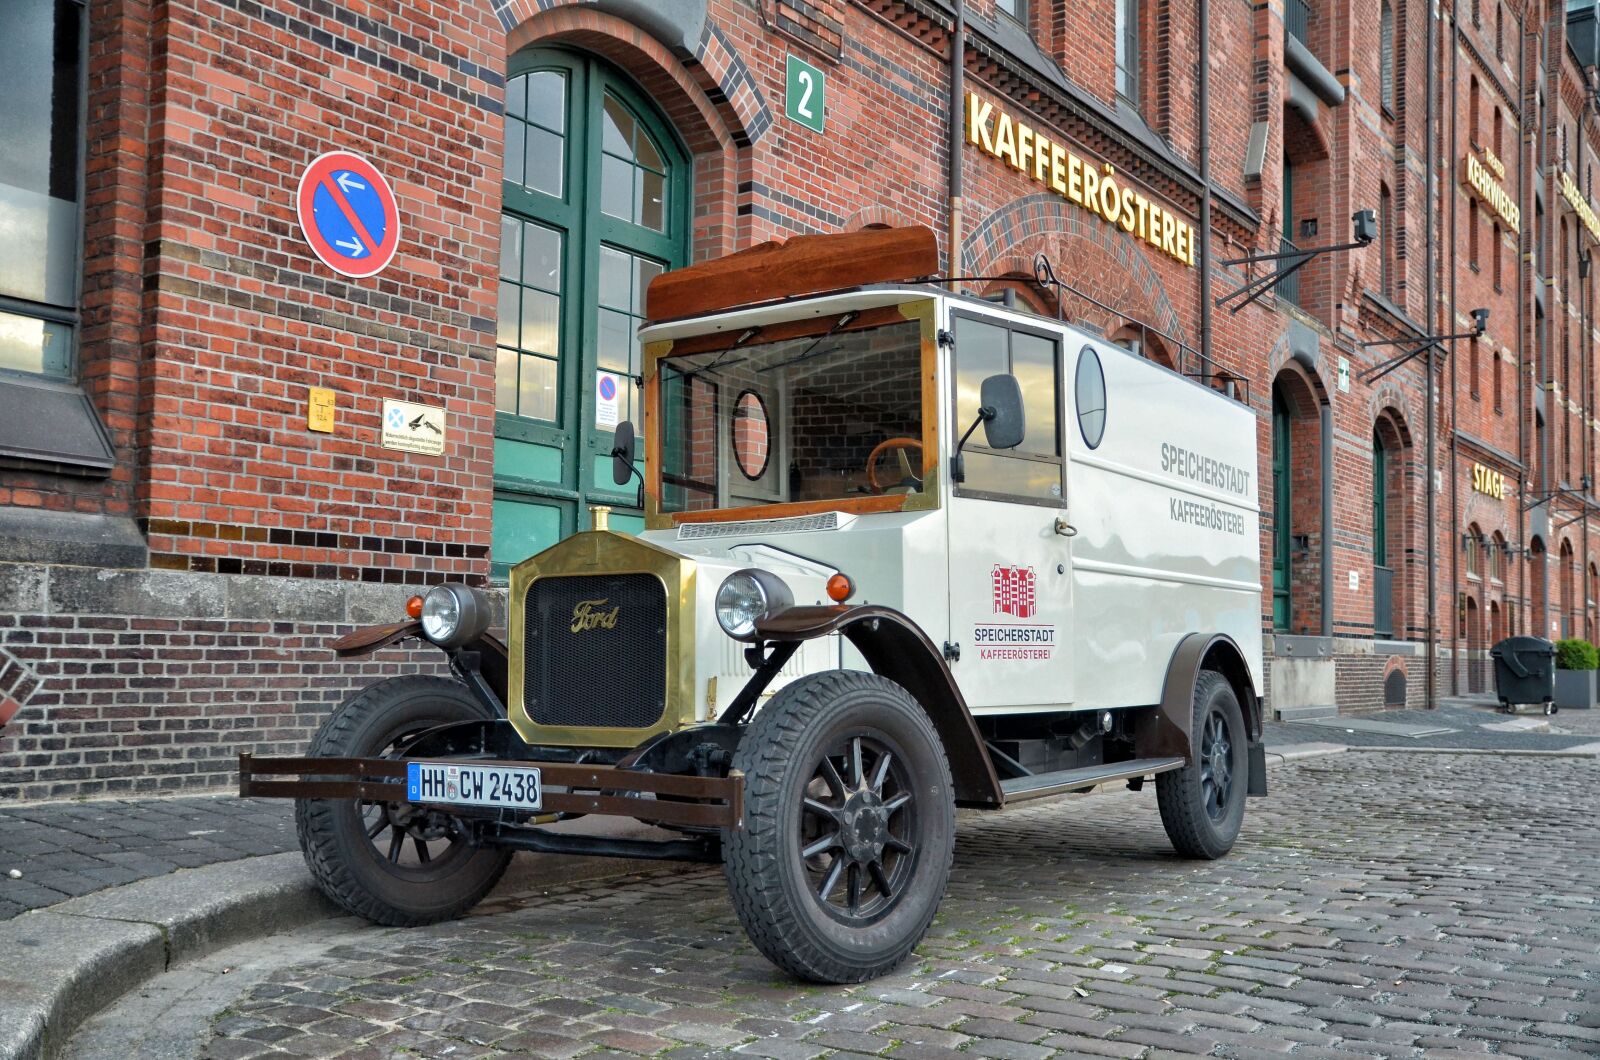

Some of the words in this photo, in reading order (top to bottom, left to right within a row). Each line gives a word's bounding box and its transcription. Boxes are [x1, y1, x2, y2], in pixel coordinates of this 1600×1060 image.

[798, 70, 813, 119] 2
[966, 92, 1194, 267] KAFFEERÖSTEREI
[1466, 152, 1520, 235] KEHRWIEDER
[1161, 442, 1250, 497] SPEICHERSTADT
[1473, 462, 1505, 500] STAGE
[1169, 496, 1245, 536] KAFFEERÖSTEREI
[570, 598, 620, 633] Ford
[974, 628, 1055, 642] SPEICHERSTADT
[980, 646, 1051, 660] KAFFEERÖSTEREI
[421, 768, 446, 798] HH
[460, 770, 484, 800] CW
[489, 772, 538, 803] 2438
